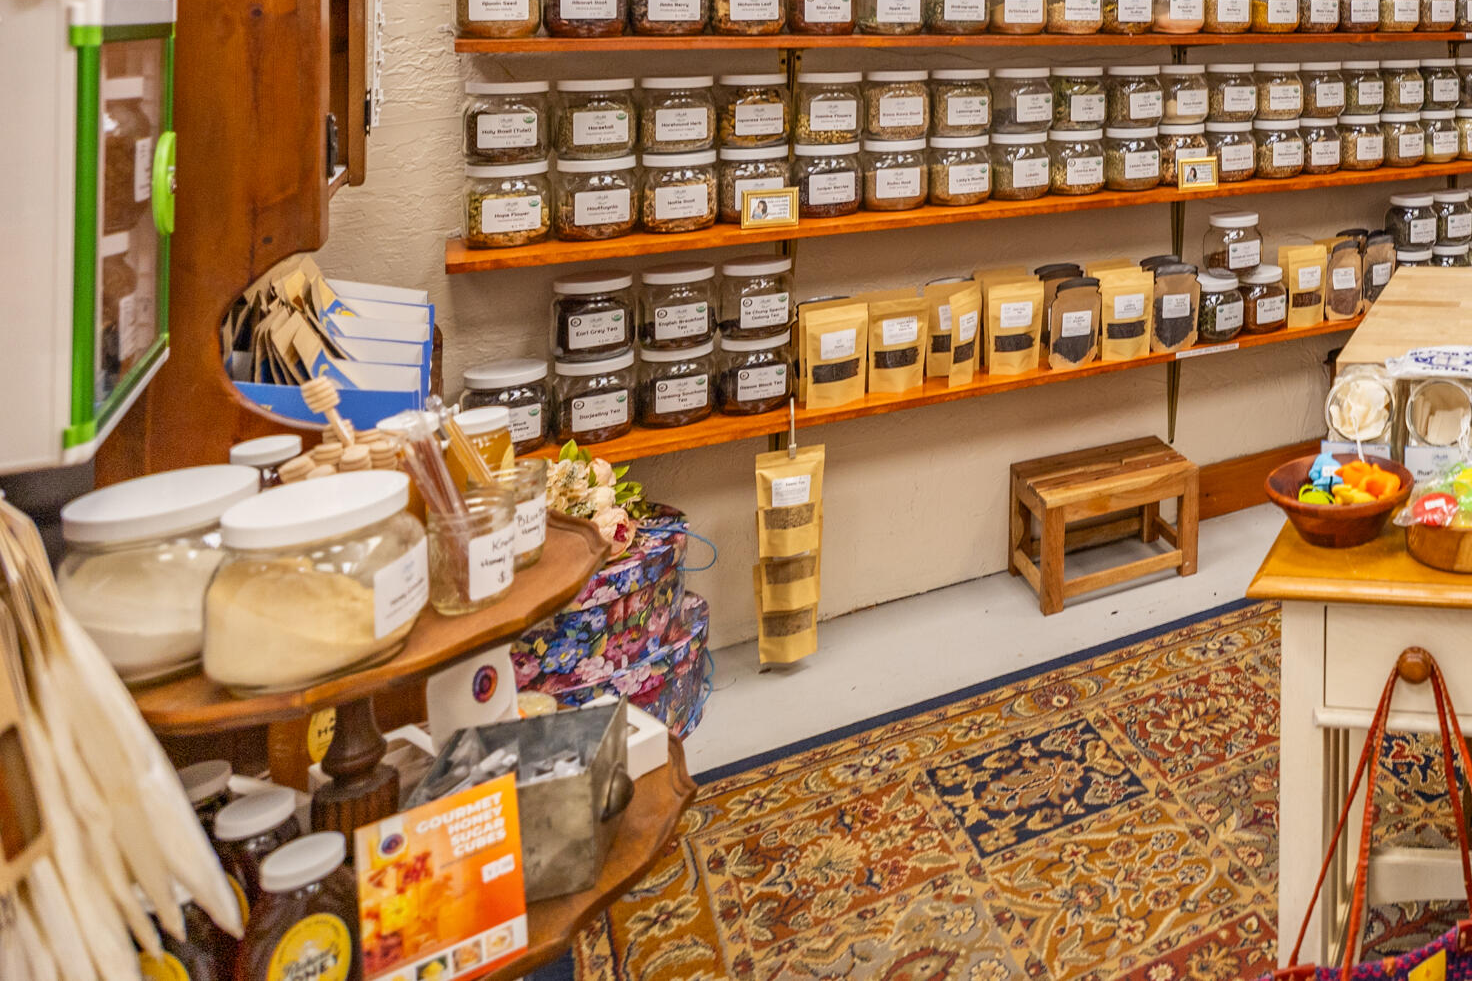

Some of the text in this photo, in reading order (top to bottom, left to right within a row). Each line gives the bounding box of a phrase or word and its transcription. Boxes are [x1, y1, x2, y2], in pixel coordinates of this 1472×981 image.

[415, 790, 503, 835] GOURMET
[448, 805, 503, 835] HONEY
[449, 817, 506, 847] SUGAR
[452, 828, 507, 858] CUBES
